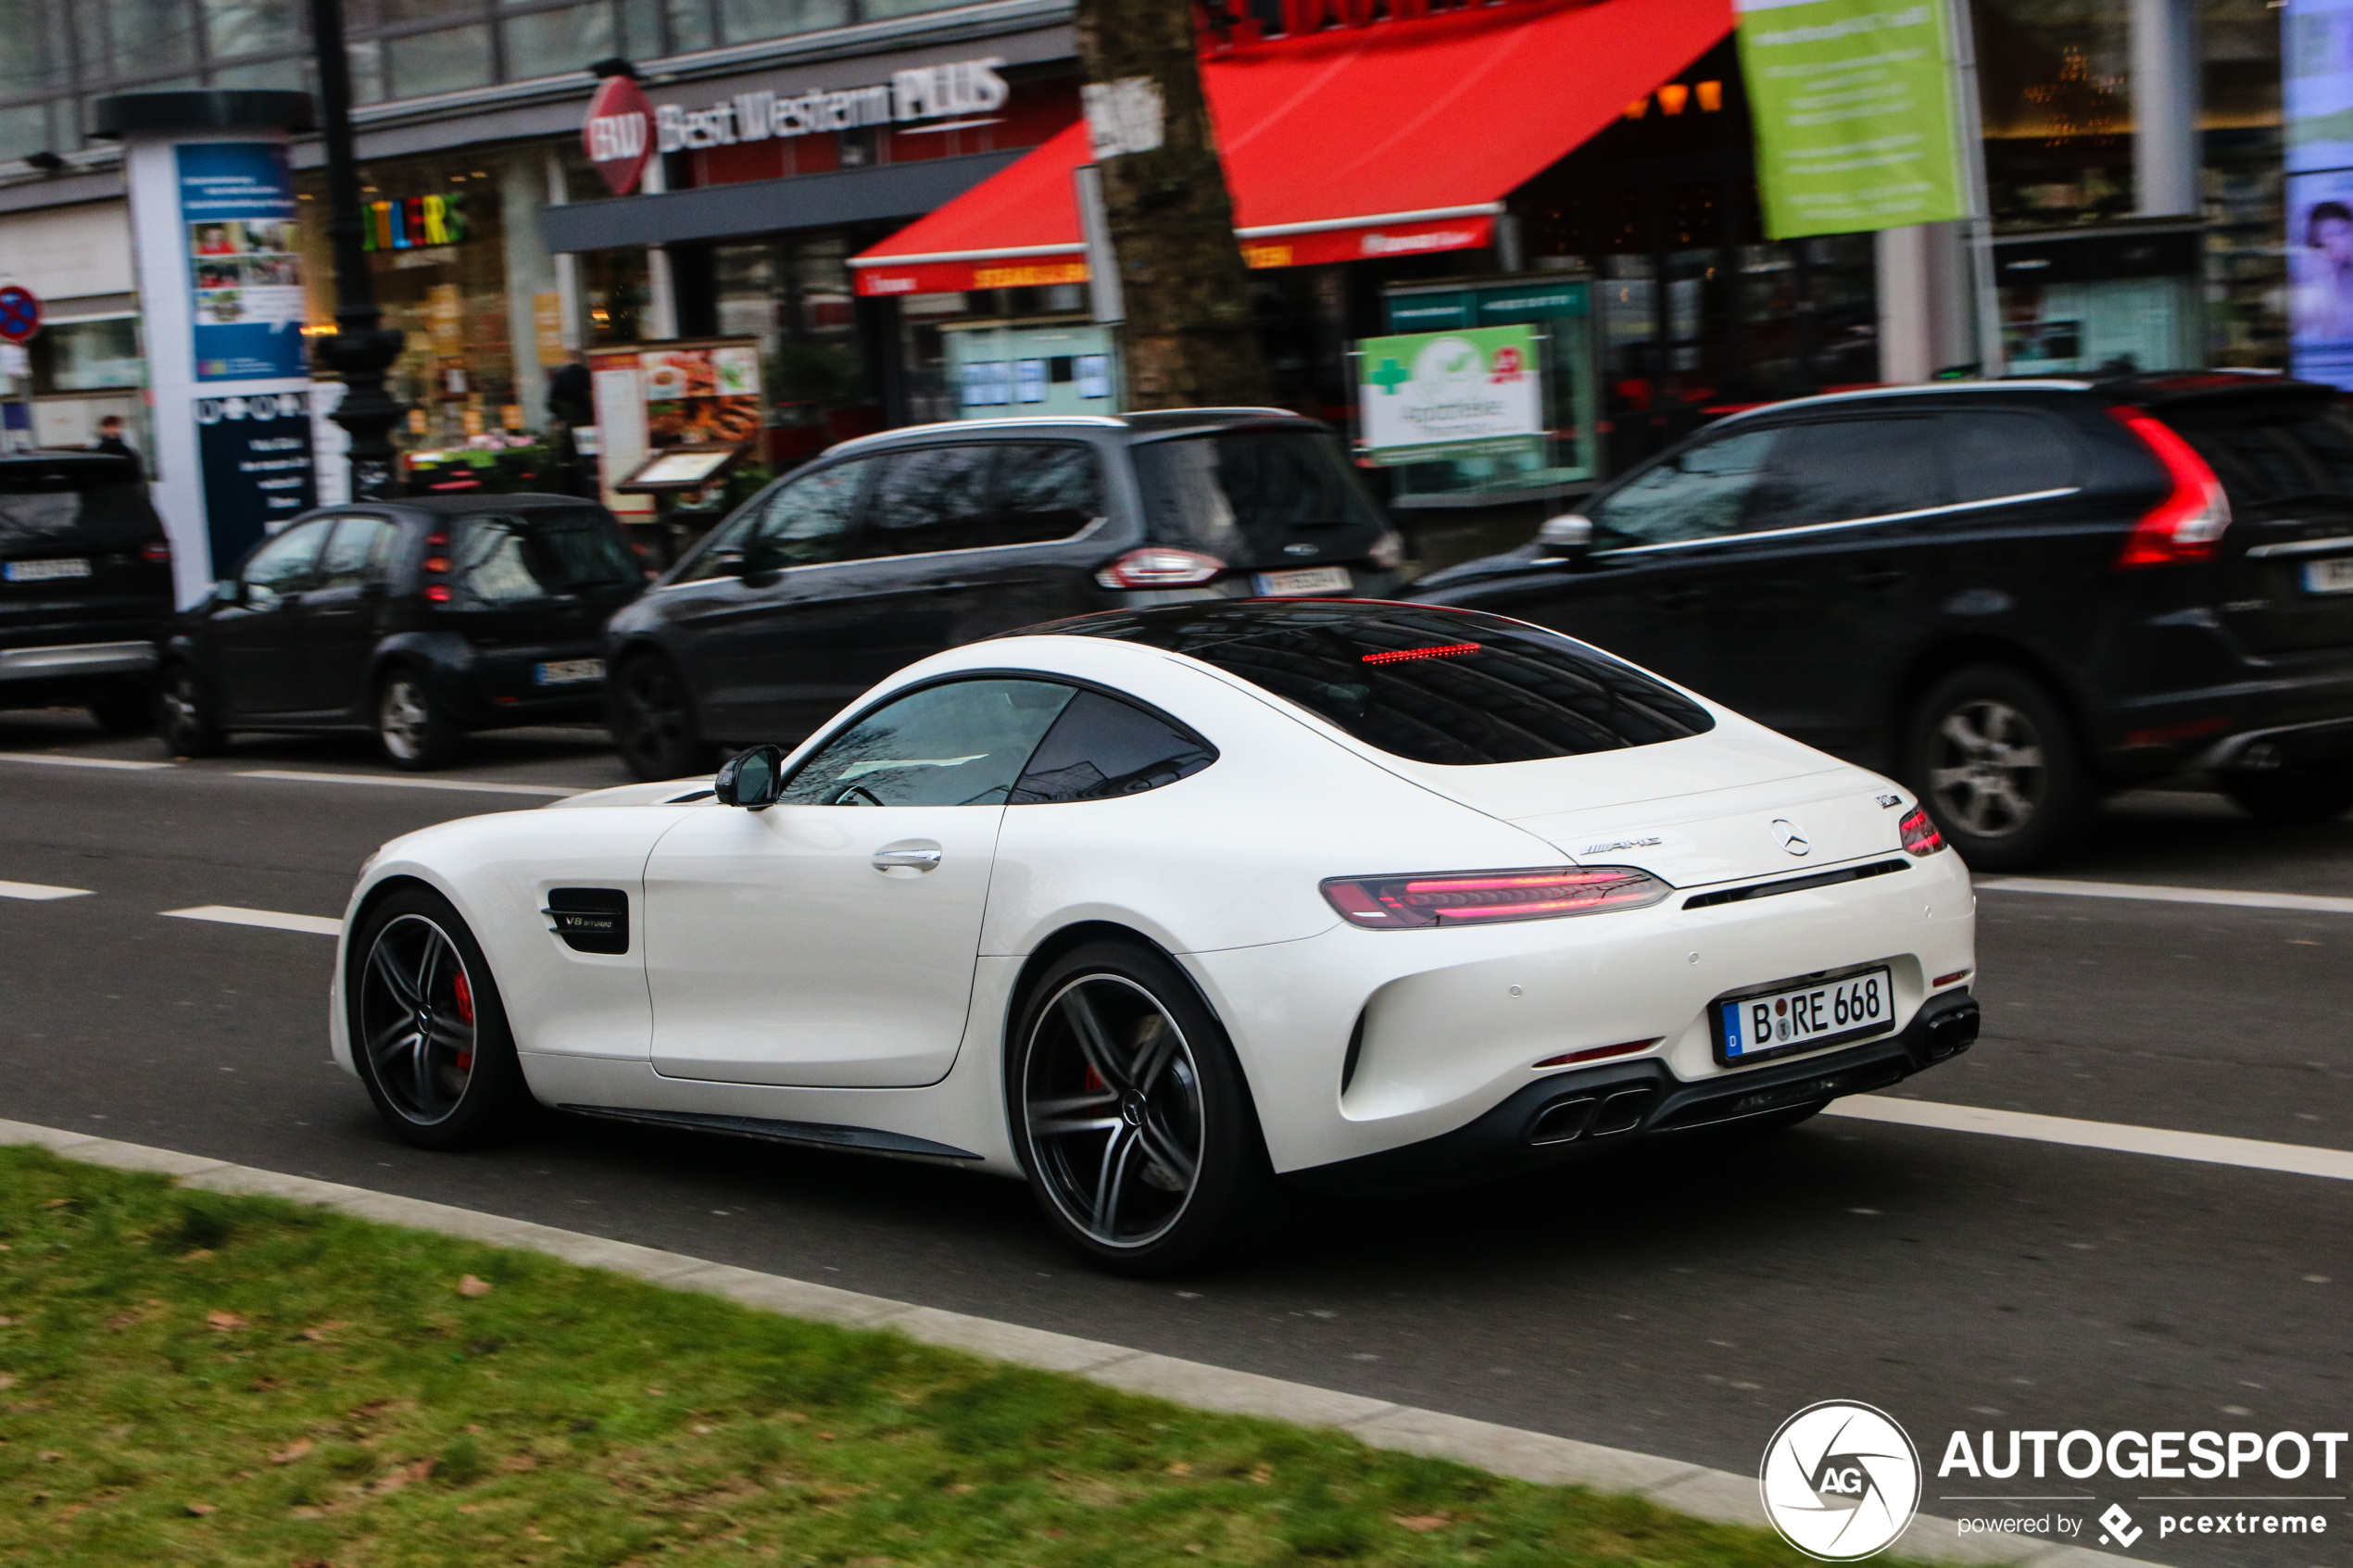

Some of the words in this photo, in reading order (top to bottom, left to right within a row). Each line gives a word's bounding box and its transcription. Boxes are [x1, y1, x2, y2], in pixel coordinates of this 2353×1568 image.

[657, 102, 736, 153] Best
[735, 88, 890, 142] Western
[892, 57, 1009, 121] PLUS
[590, 112, 647, 161] BW
[566, 917, 583, 925] V8
[1730, 1035, 1737, 1047] D
[1753, 1003, 1772, 1044] B
[1792, 990, 1829, 1035] RE
[1834, 978, 1880, 1025] 668
